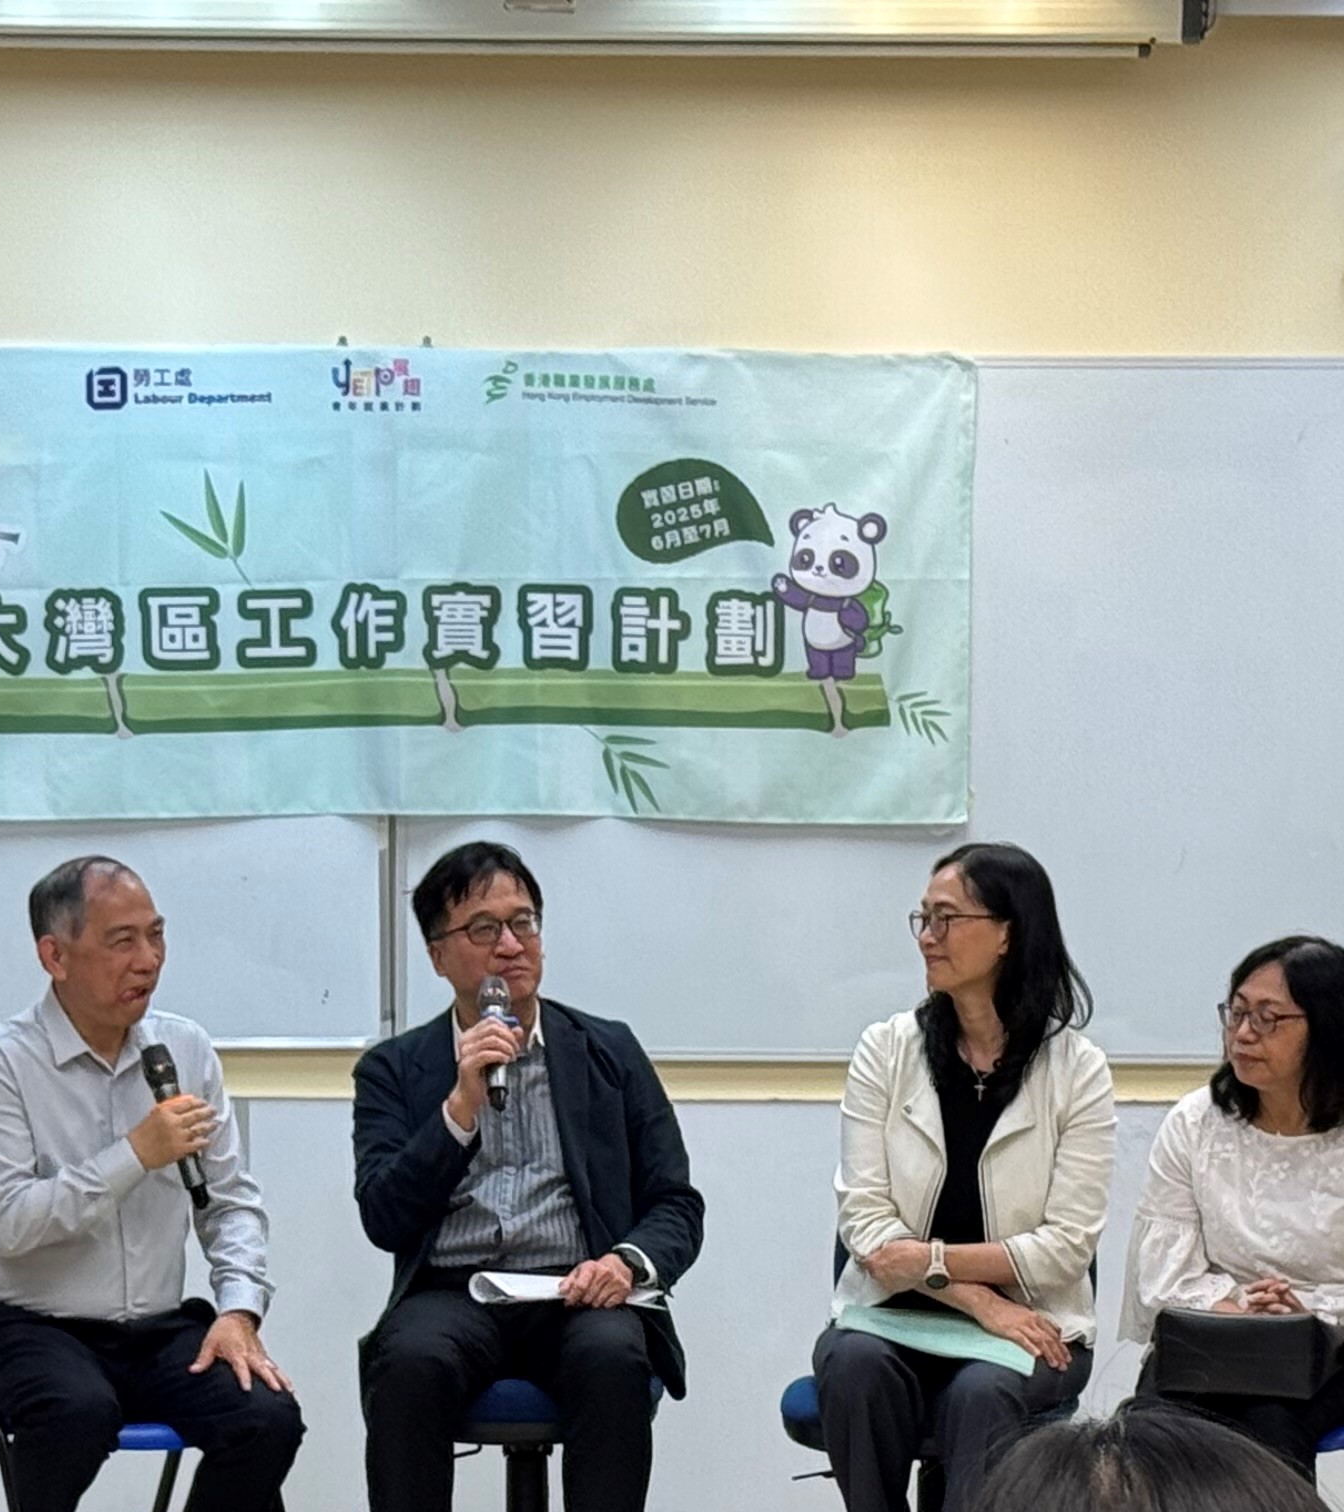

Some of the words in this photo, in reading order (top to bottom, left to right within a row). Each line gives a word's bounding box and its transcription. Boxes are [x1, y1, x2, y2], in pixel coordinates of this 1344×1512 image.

[133, 368, 193, 387] 勞工處
[134, 392, 184, 405] Labour
[188, 392, 272, 406] Department
[521, 391, 546, 403] Hong
[547, 392, 570, 404] Kong
[651, 497, 721, 528] 2025年
[650, 517, 731, 551] 6月至7月
